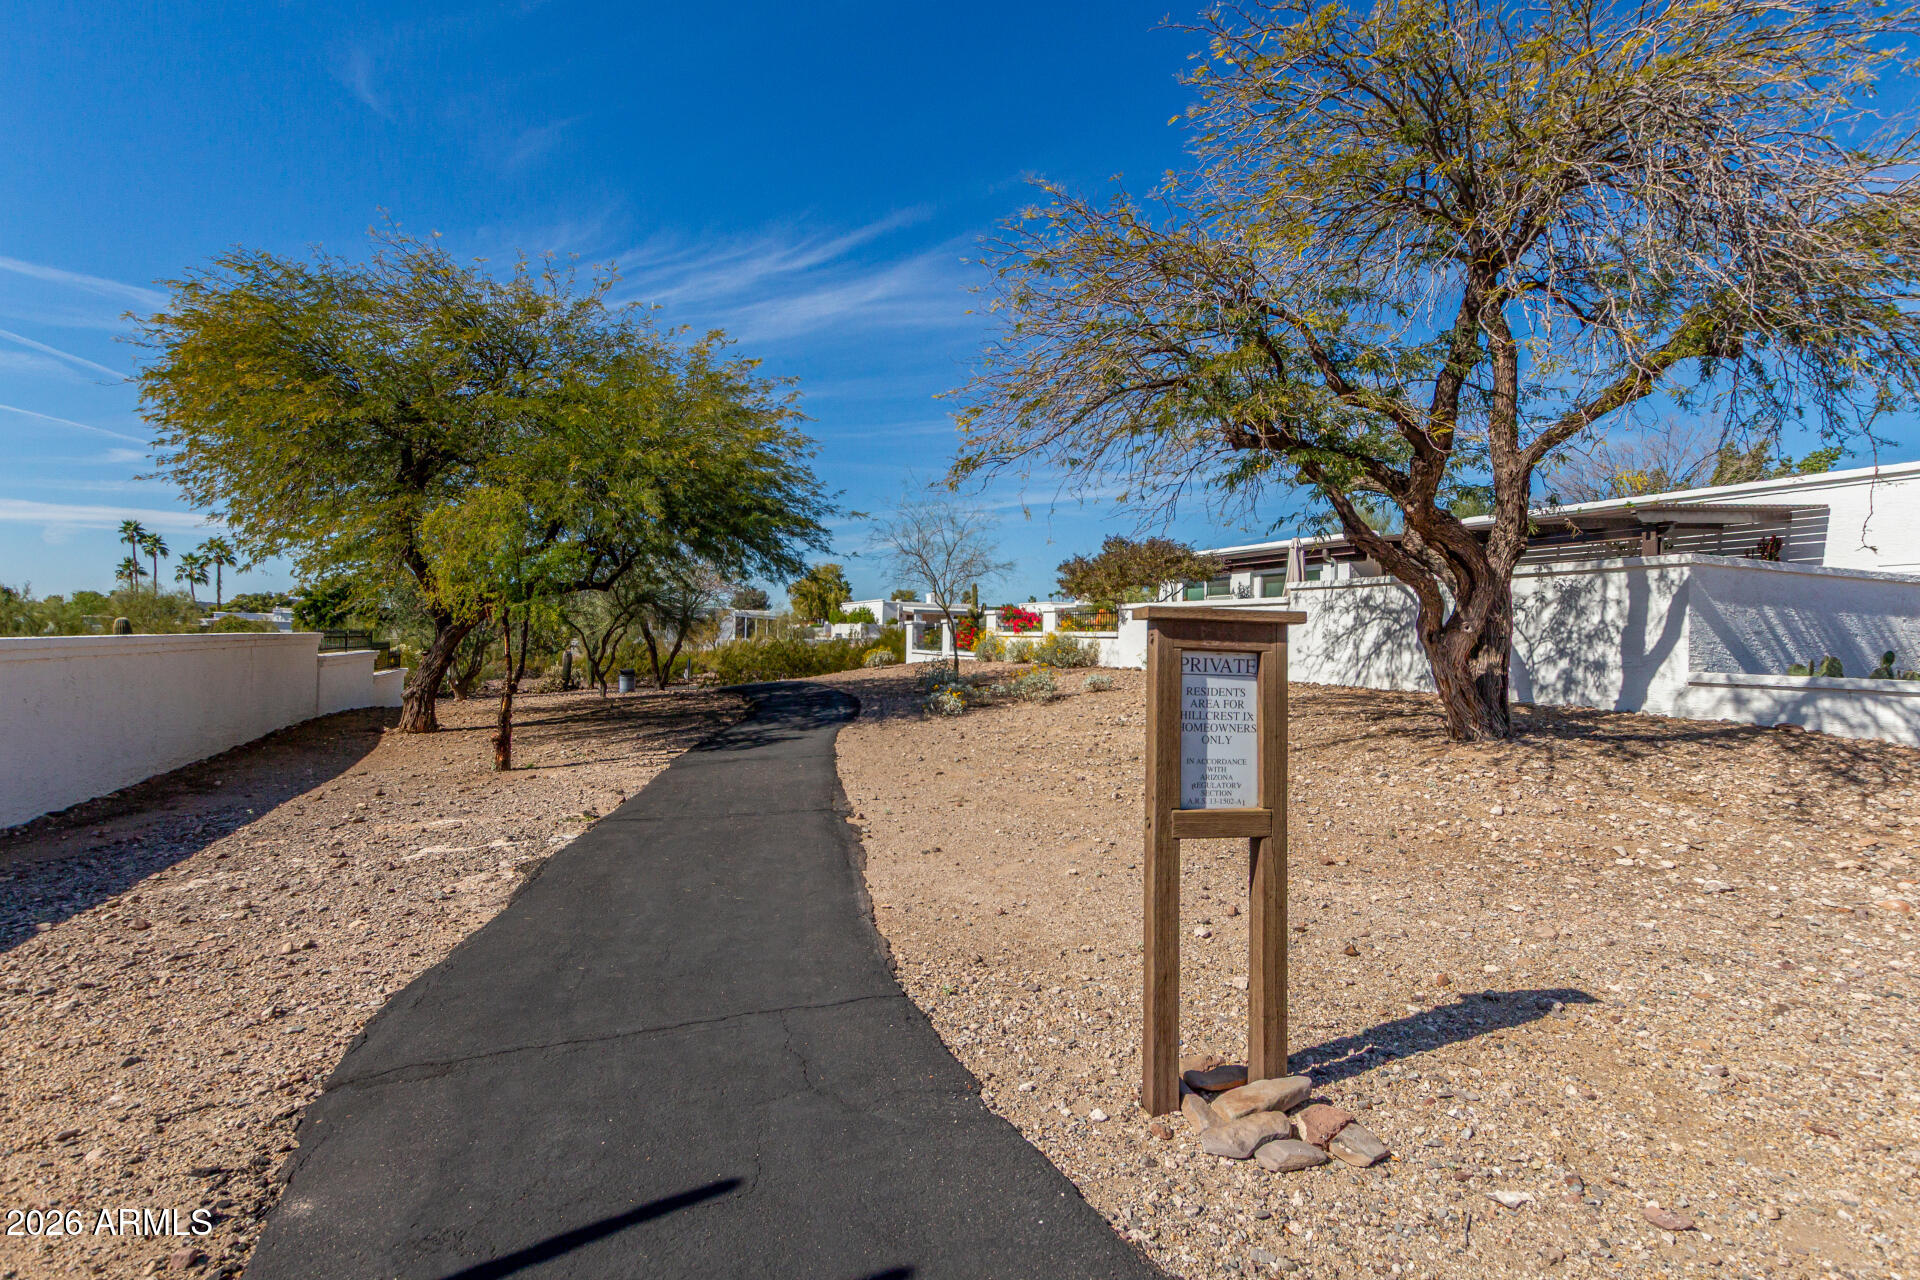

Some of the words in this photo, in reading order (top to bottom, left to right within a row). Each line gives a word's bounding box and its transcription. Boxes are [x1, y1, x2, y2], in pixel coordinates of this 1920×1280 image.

[1181, 656, 1257, 675] PRIVATE
[1186, 687, 1246, 697] RESIDENTS
[1190, 699, 1220, 709] AREA
[1223, 699, 1244, 709] FOR
[1181, 710, 1240, 721] HILLCREST
[1243, 711, 1254, 721] IX
[1181, 722, 1257, 734] HOMEOWNERS
[1201, 735, 1232, 745] ONLY
[1197, 758, 1247, 766] ACCORDANCE
